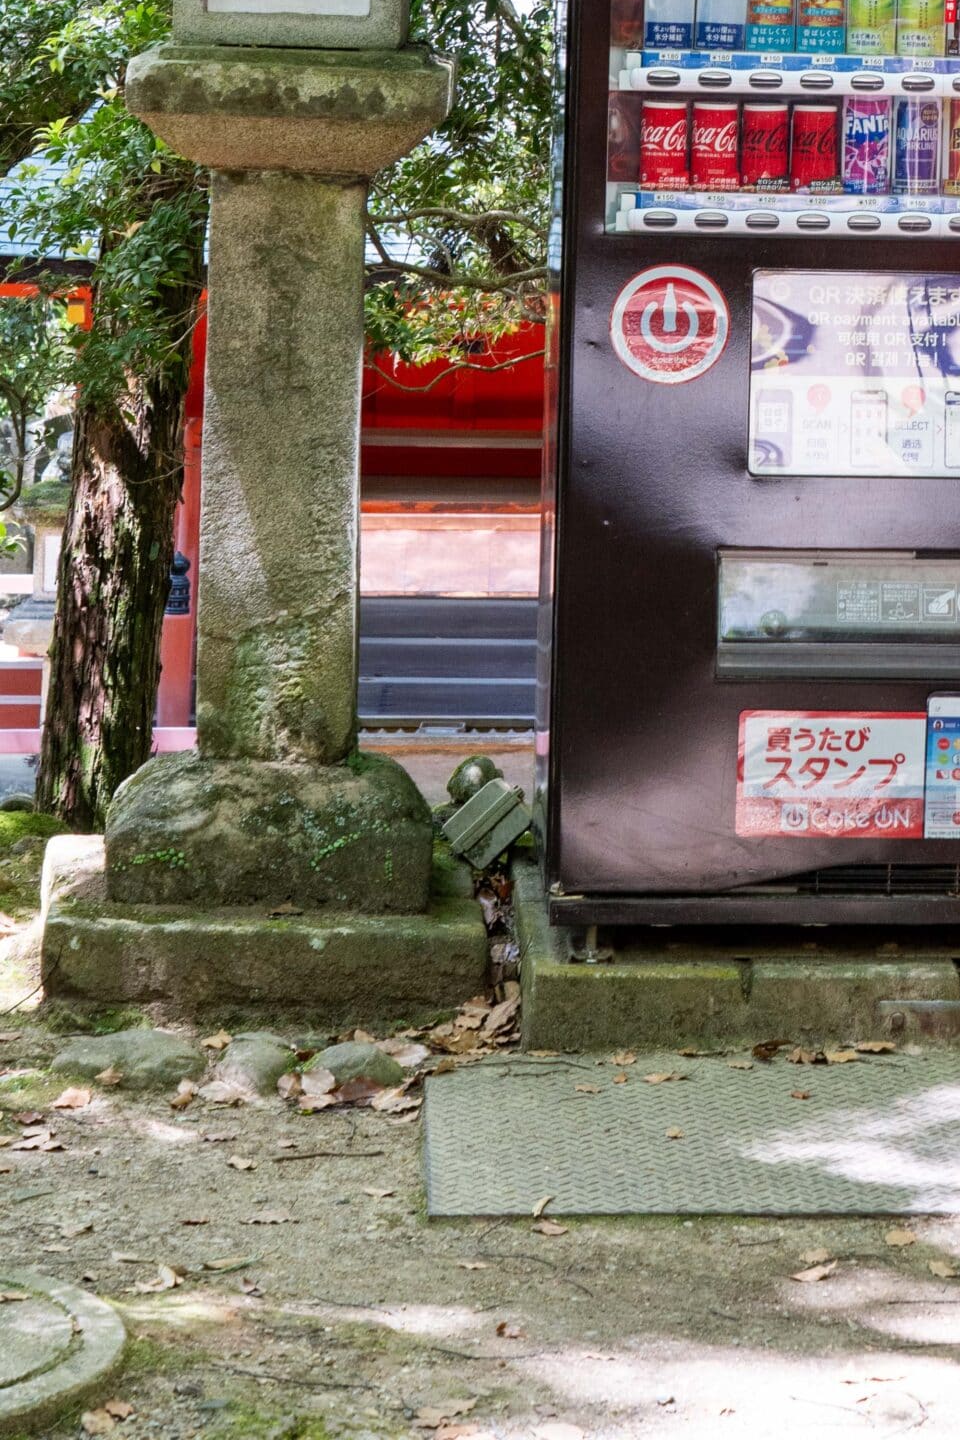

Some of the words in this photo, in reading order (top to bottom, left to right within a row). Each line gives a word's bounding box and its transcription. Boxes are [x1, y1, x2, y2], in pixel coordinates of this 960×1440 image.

[654, 33, 683, 42] 水分補給
[706, 34, 734, 43] 水分補給
[809, 287, 840, 305] QR
[808, 313, 832, 326] QR
[834, 314, 898, 328] payment
[884, 333, 906, 346] QR
[845, 354, 865, 367] QR
[803, 420, 832, 430] SCAN
[765, 726, 871, 752] 買うたび
[763, 752, 906, 791] スタンプ
[811, 809, 870, 828] Coke
[874, 806, 911, 829] ON
